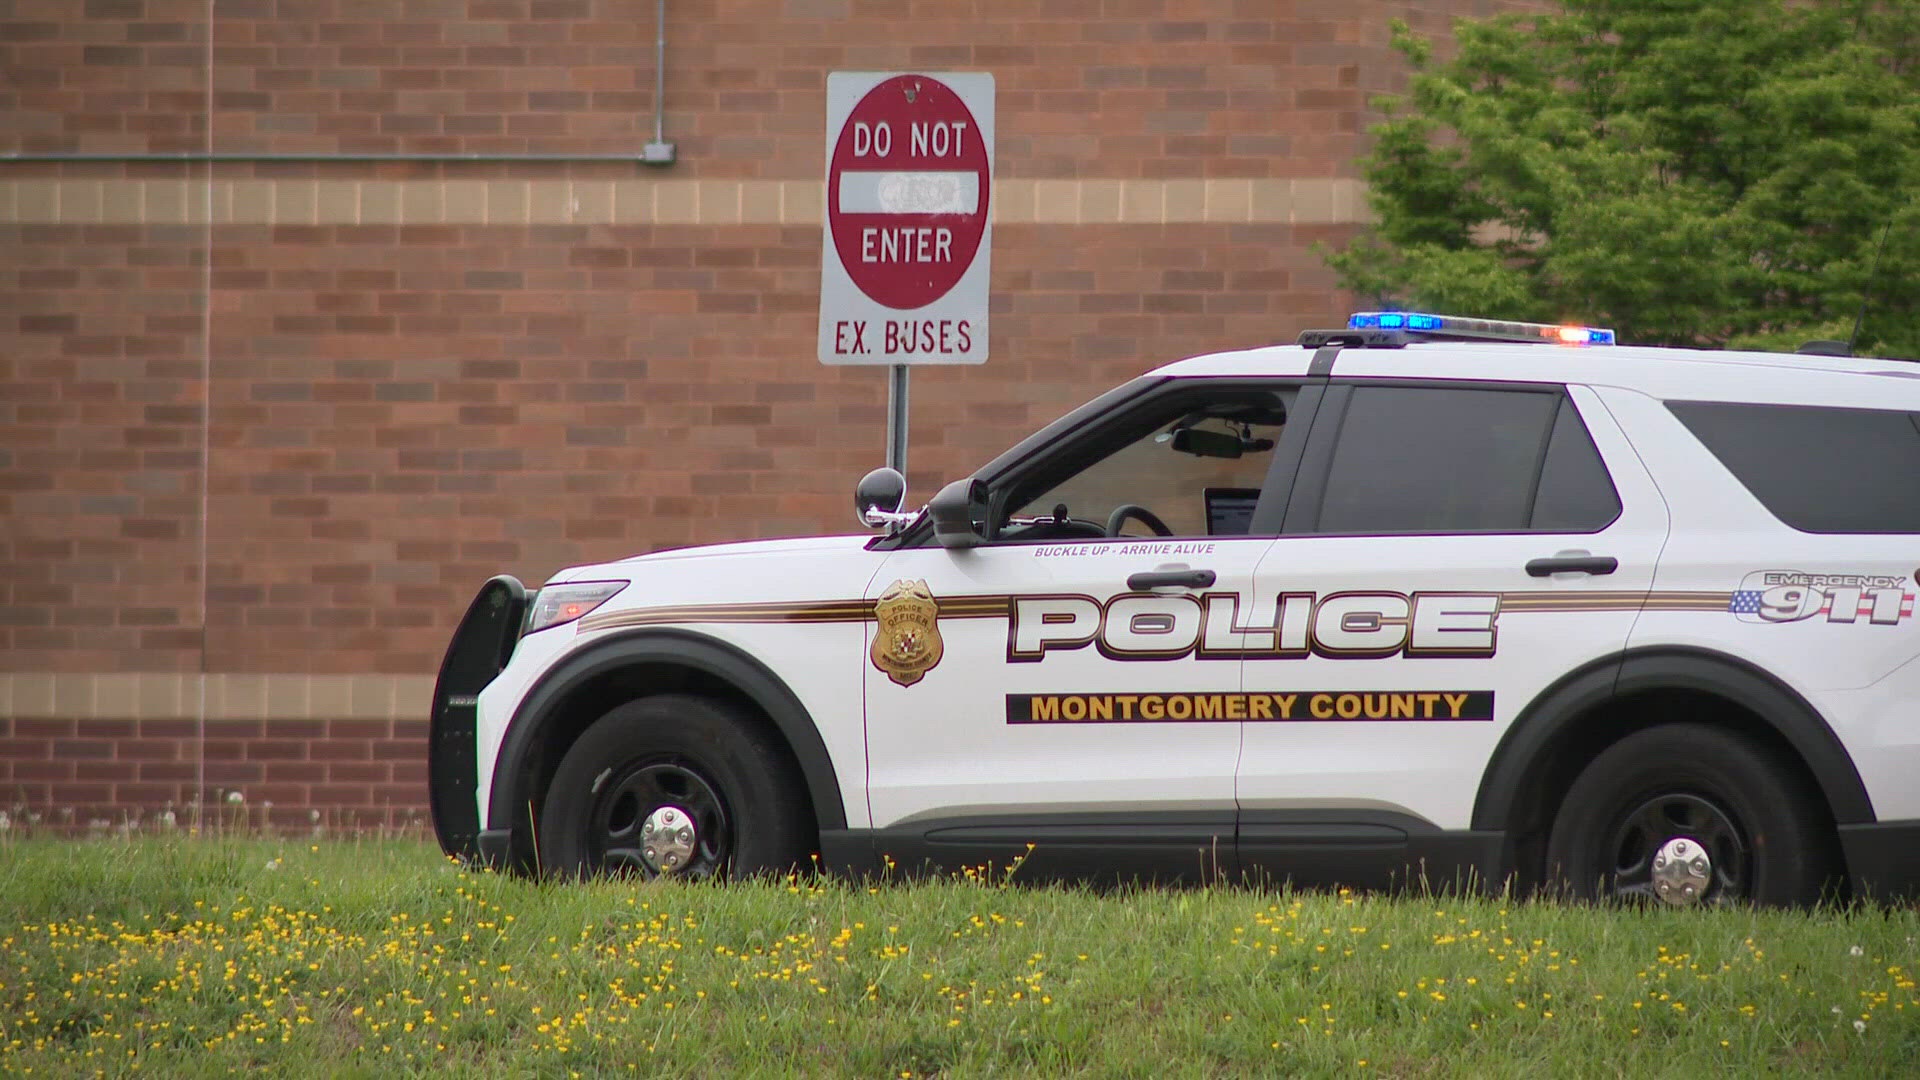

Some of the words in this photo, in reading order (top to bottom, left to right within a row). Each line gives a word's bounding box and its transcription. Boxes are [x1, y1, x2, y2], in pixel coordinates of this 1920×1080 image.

[853, 121, 892, 157] DO
[910, 121, 967, 157] NOT
[861, 227, 952, 263] ENTER
[834, 320, 871, 355] EX.
[884, 319, 972, 355] BUSES
[1035, 546, 1088, 557] BUCKLE
[1091, 545, 1110, 556] UP
[1120, 544, 1171, 555] ARRIVE
[1173, 543, 1215, 554] ALIVE
[1764, 572, 1907, 588] EMERGENCY
[888, 613, 928, 627] OFFICER
[892, 604, 922, 612] POLICE
[1757, 584, 1906, 626] 911
[1006, 591, 1501, 663] POLICE
[1030, 693, 1298, 721] MONTGOMERY
[1309, 692, 1470, 720] COUNTY
